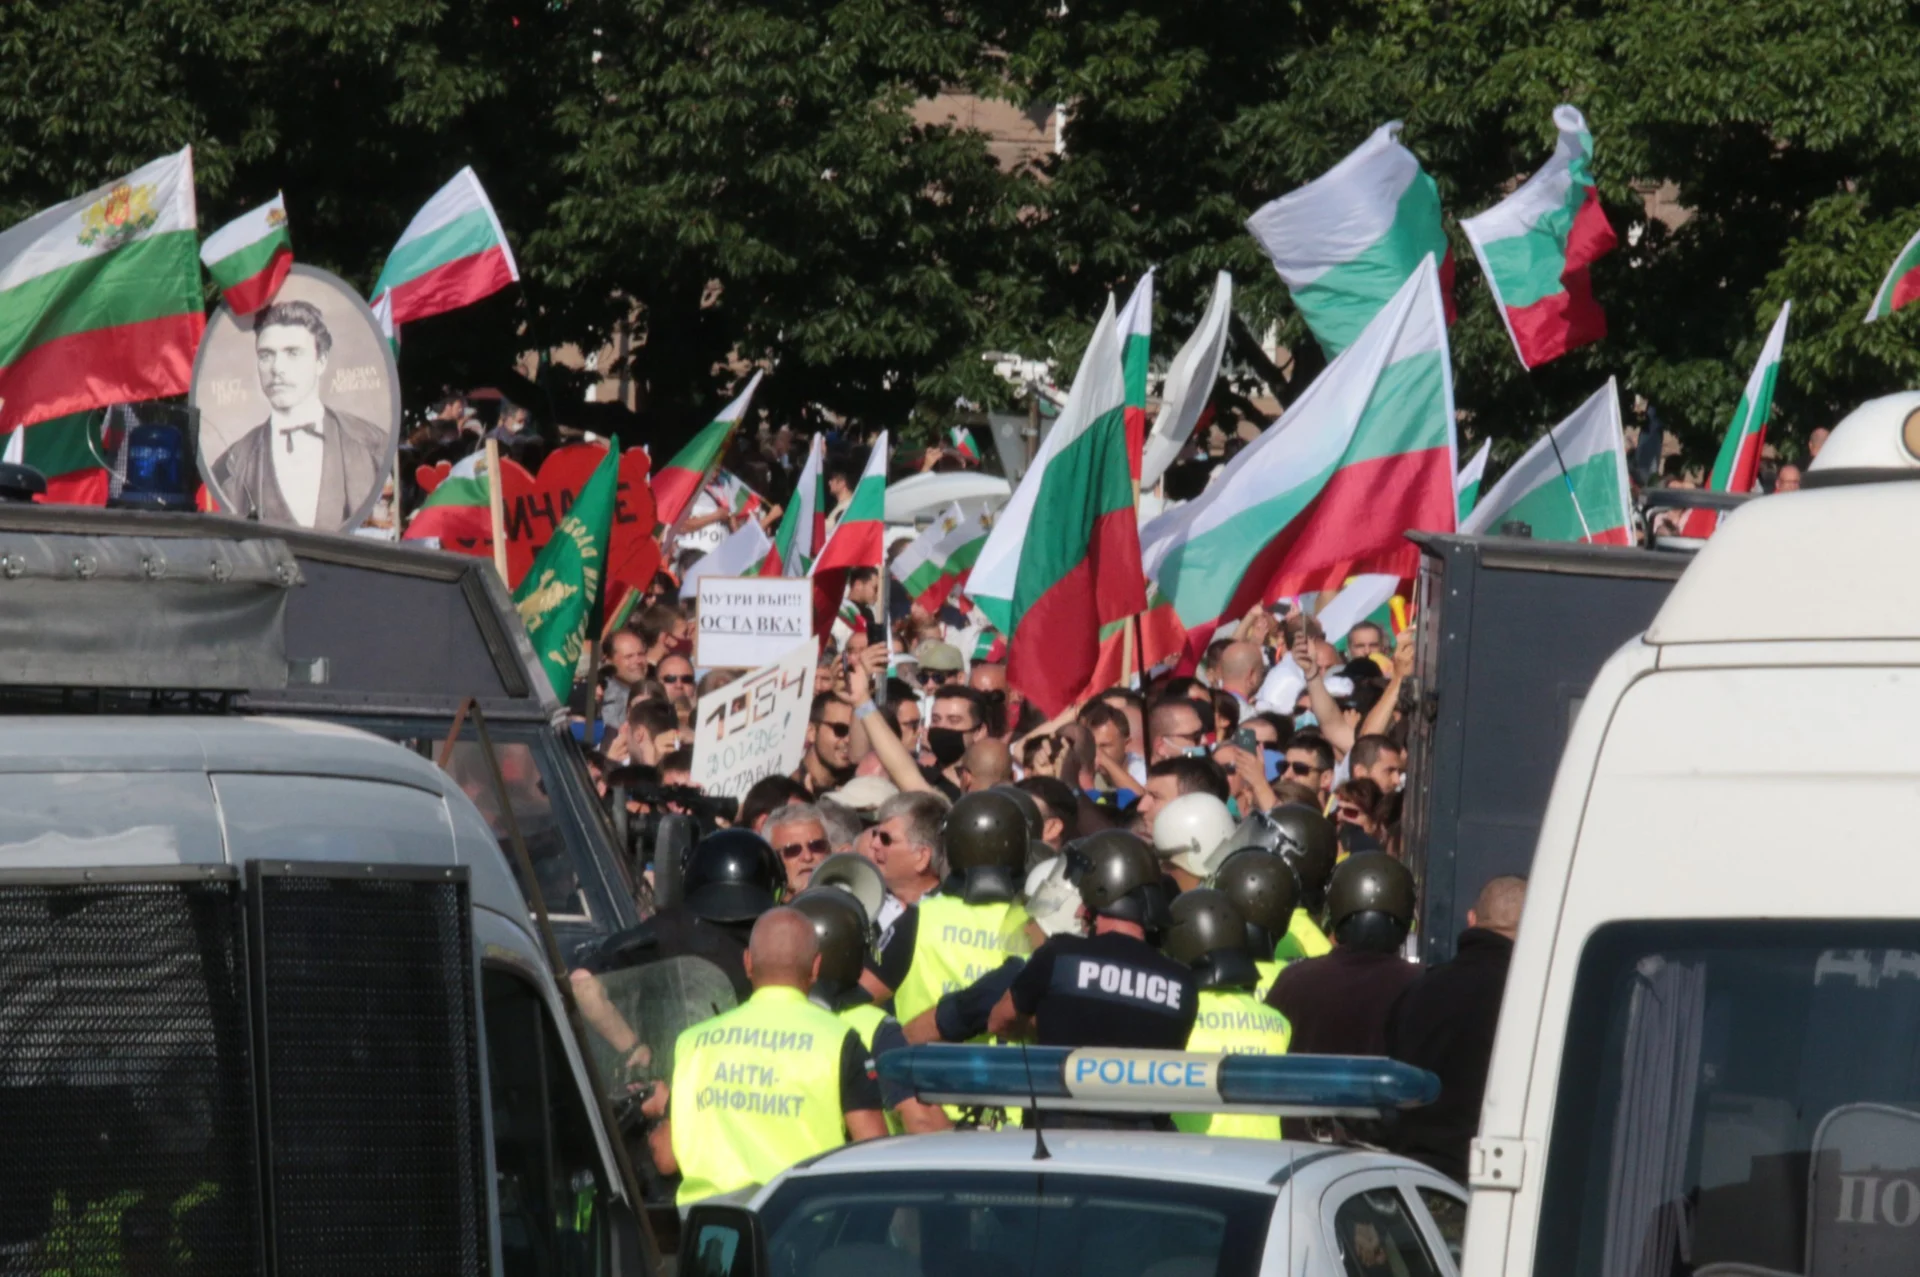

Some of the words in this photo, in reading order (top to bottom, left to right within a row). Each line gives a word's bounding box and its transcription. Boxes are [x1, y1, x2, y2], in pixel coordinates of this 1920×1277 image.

[702, 593, 752, 606] МУТРИ
[1077, 961, 1182, 1010] POLICE
[694, 1026, 814, 1053] ПОЛИЦИЯ
[714, 1061, 780, 1087] АНТИ-
[1076, 1058, 1206, 1088] POLICE
[695, 1086, 805, 1118] КОНФЛИКТ
